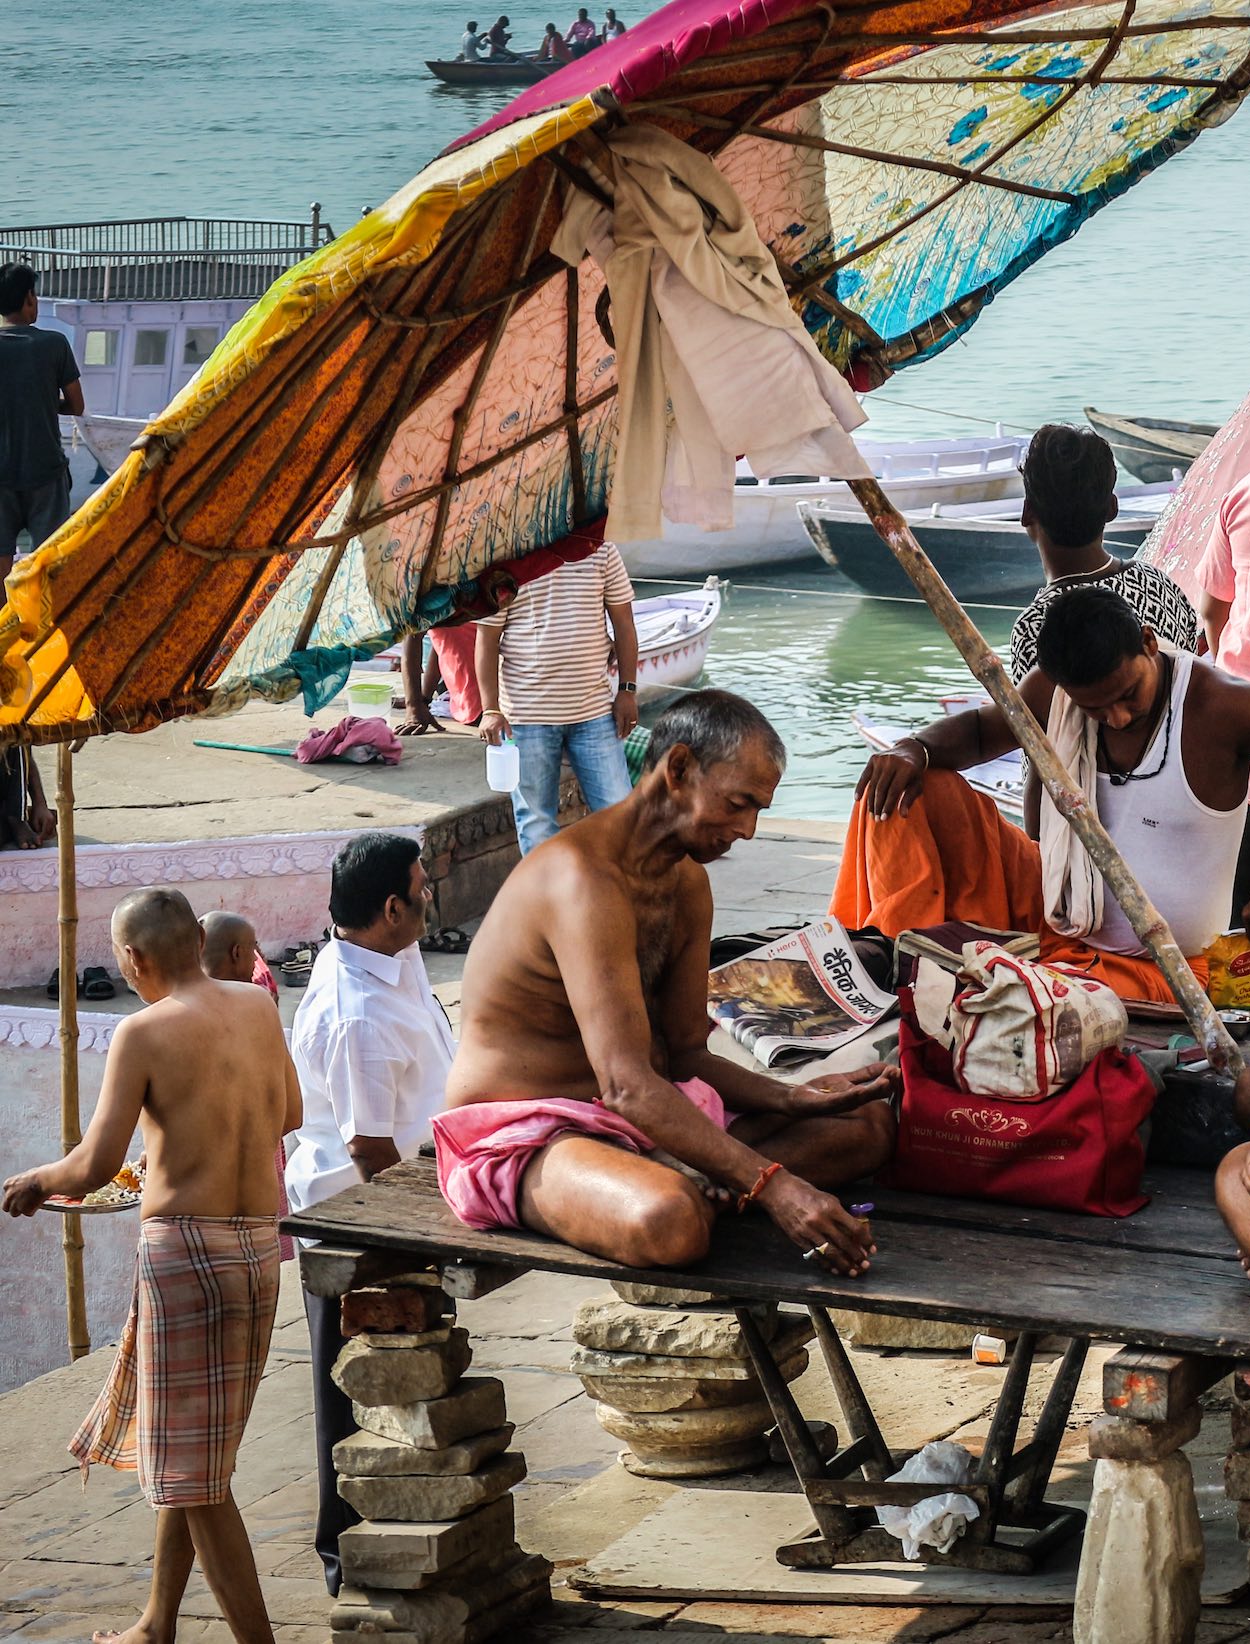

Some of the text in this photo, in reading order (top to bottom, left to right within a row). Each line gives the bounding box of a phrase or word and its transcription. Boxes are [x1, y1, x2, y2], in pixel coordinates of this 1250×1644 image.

[823, 947, 858, 993] दैनिक
[963, 1135, 971, 1145] JI
[973, 1136, 1026, 1150] ORNAMENT
